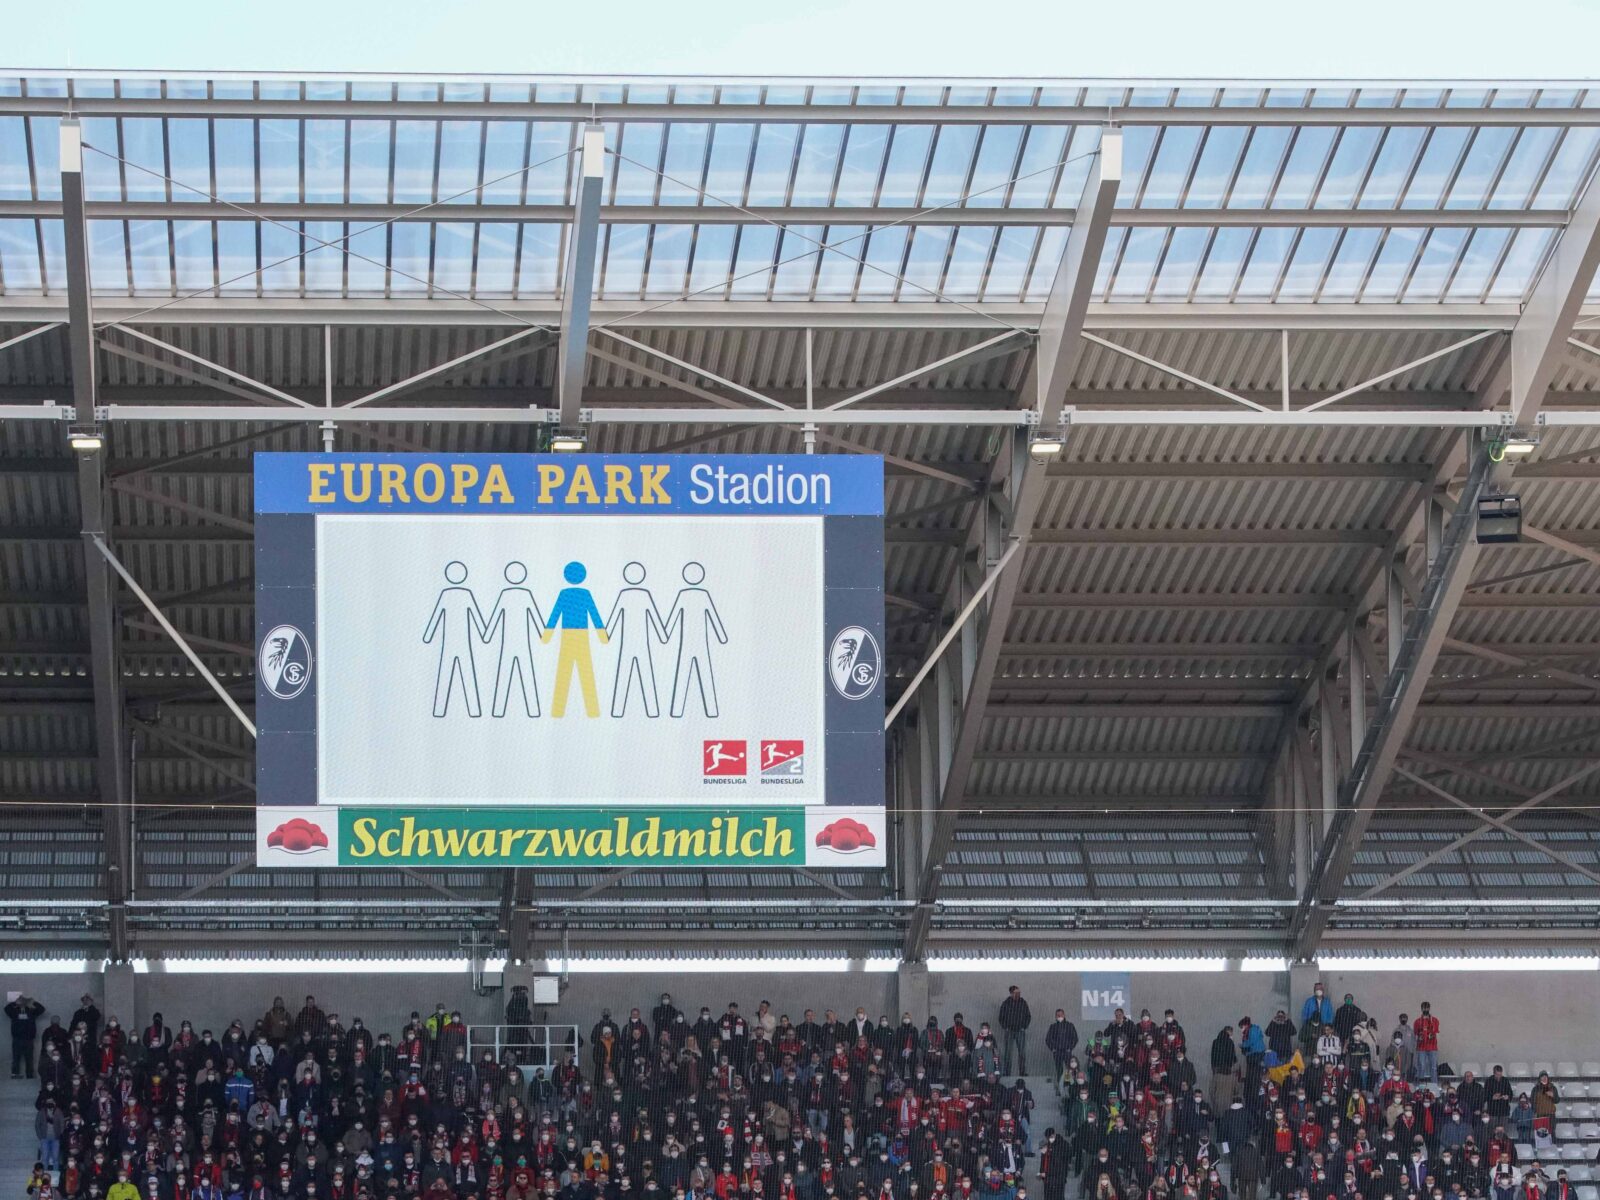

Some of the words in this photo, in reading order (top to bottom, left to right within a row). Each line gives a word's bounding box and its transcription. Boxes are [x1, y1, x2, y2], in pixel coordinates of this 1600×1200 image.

[308, 463, 514, 504] EUROPA
[537, 464, 671, 504] PARK
[690, 464, 831, 505] Stadion
[350, 817, 795, 859] Schwarzwaldmilch
[1082, 989, 1126, 1007] N14
